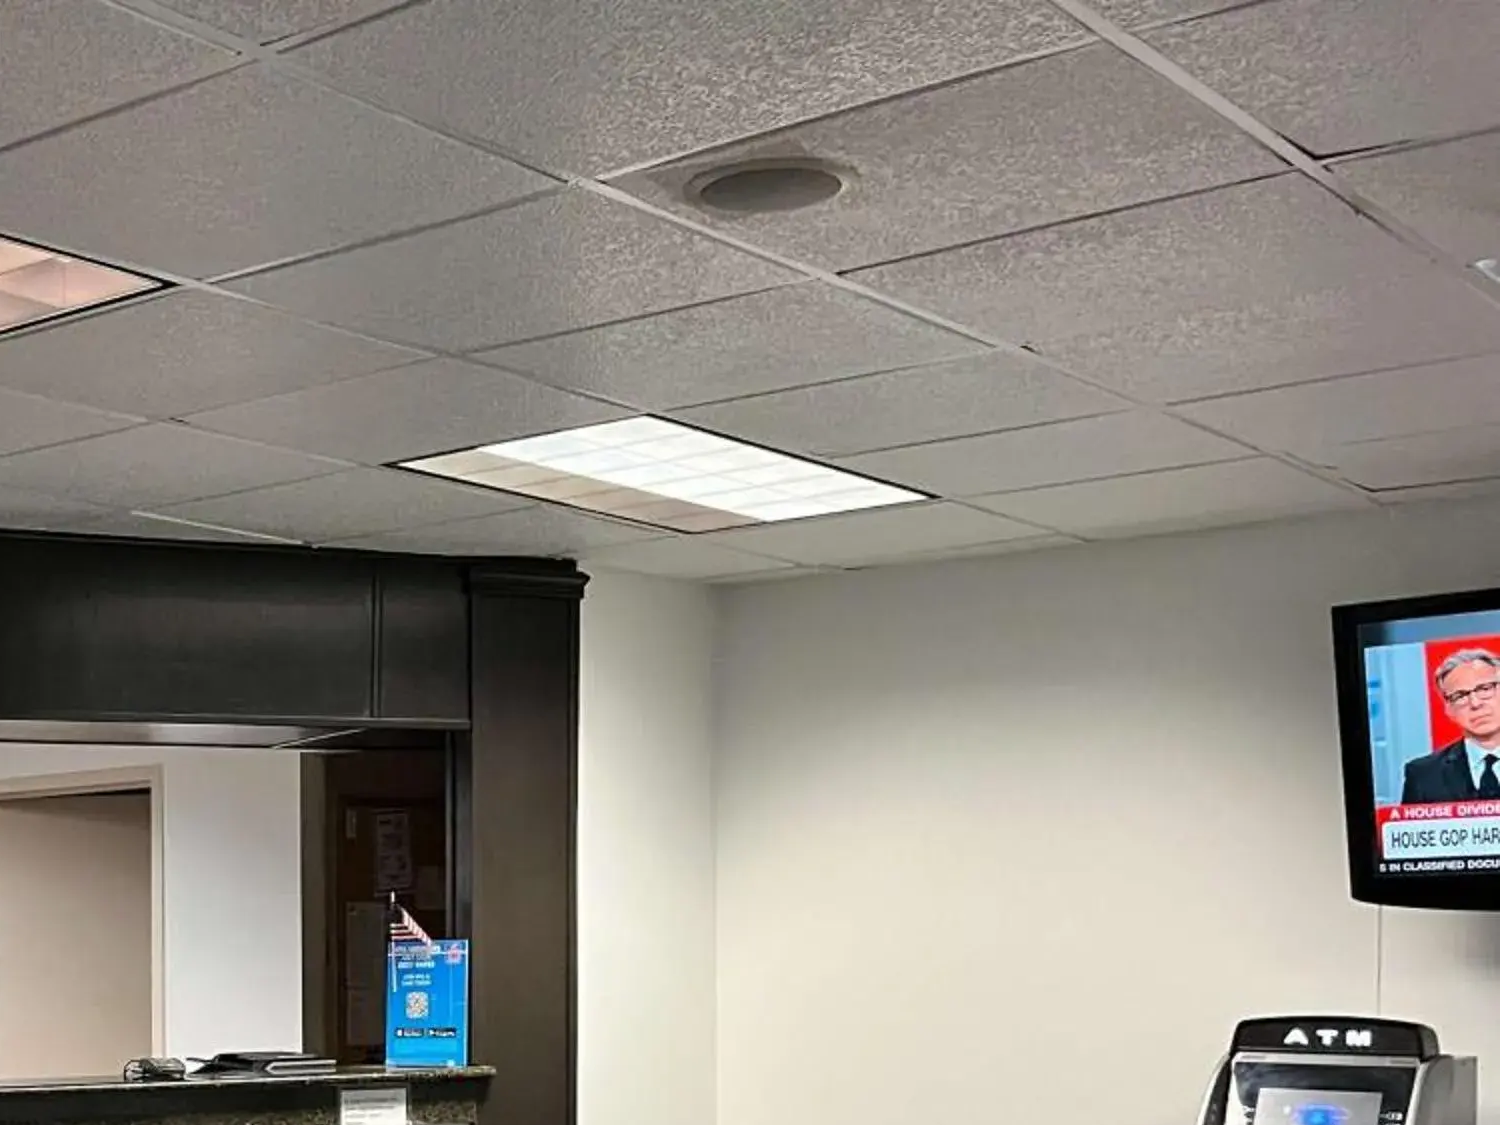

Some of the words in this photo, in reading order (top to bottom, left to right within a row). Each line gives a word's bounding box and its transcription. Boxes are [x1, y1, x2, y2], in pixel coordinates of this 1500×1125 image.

[1389, 809, 1401, 820] A
[1405, 806, 1452, 819] HOUSE
[1391, 830, 1436, 849] HOUSE
[1440, 828, 1468, 847] GOP
[1389, 863, 1401, 872] IN
[1403, 860, 1465, 872] CLASSIFIED
[1283, 1026, 1373, 1048] ATM
